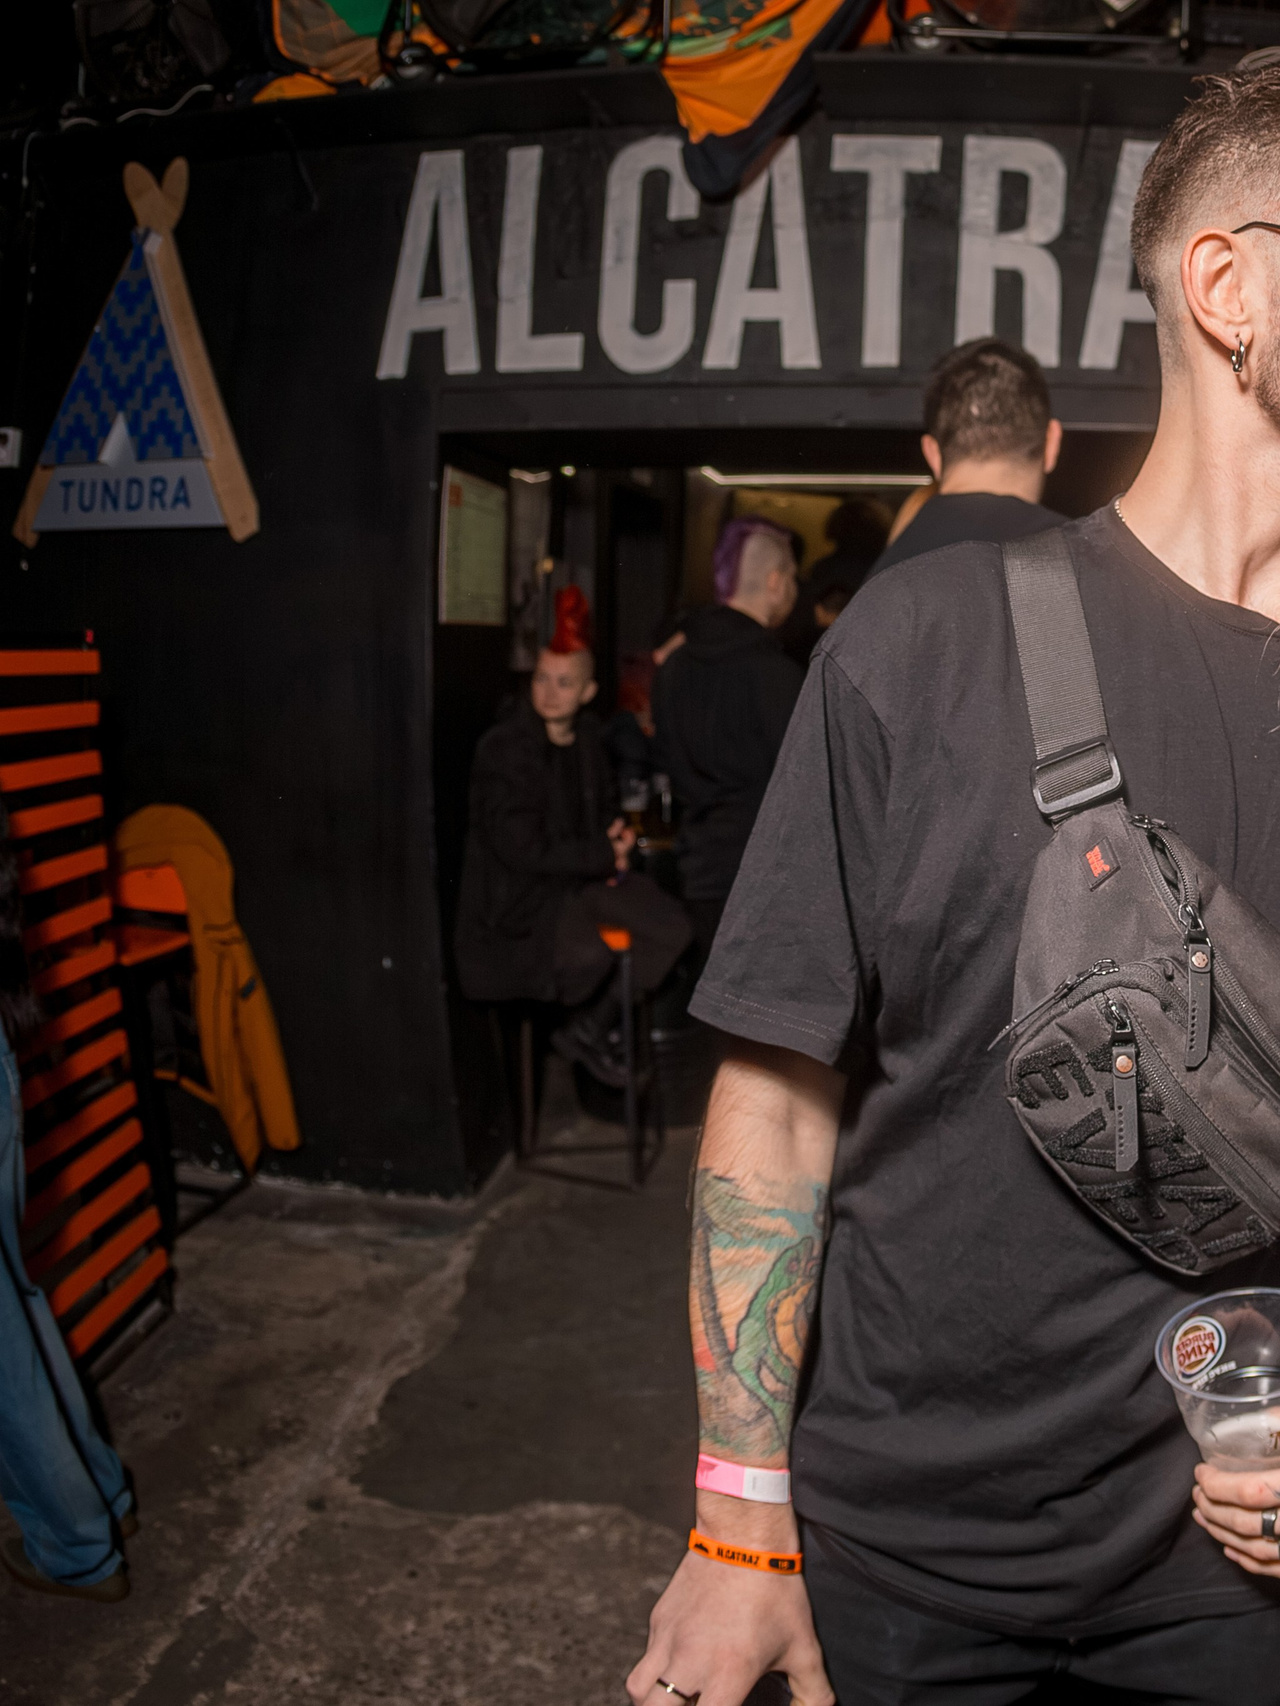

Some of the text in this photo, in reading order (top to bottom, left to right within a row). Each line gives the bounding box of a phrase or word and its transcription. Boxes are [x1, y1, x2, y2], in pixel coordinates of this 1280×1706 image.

[375, 133, 1159, 379] ALCATRA
[59, 475, 191, 513] TUNDRA
[717, 1546, 761, 1566] ALCATRAZ
